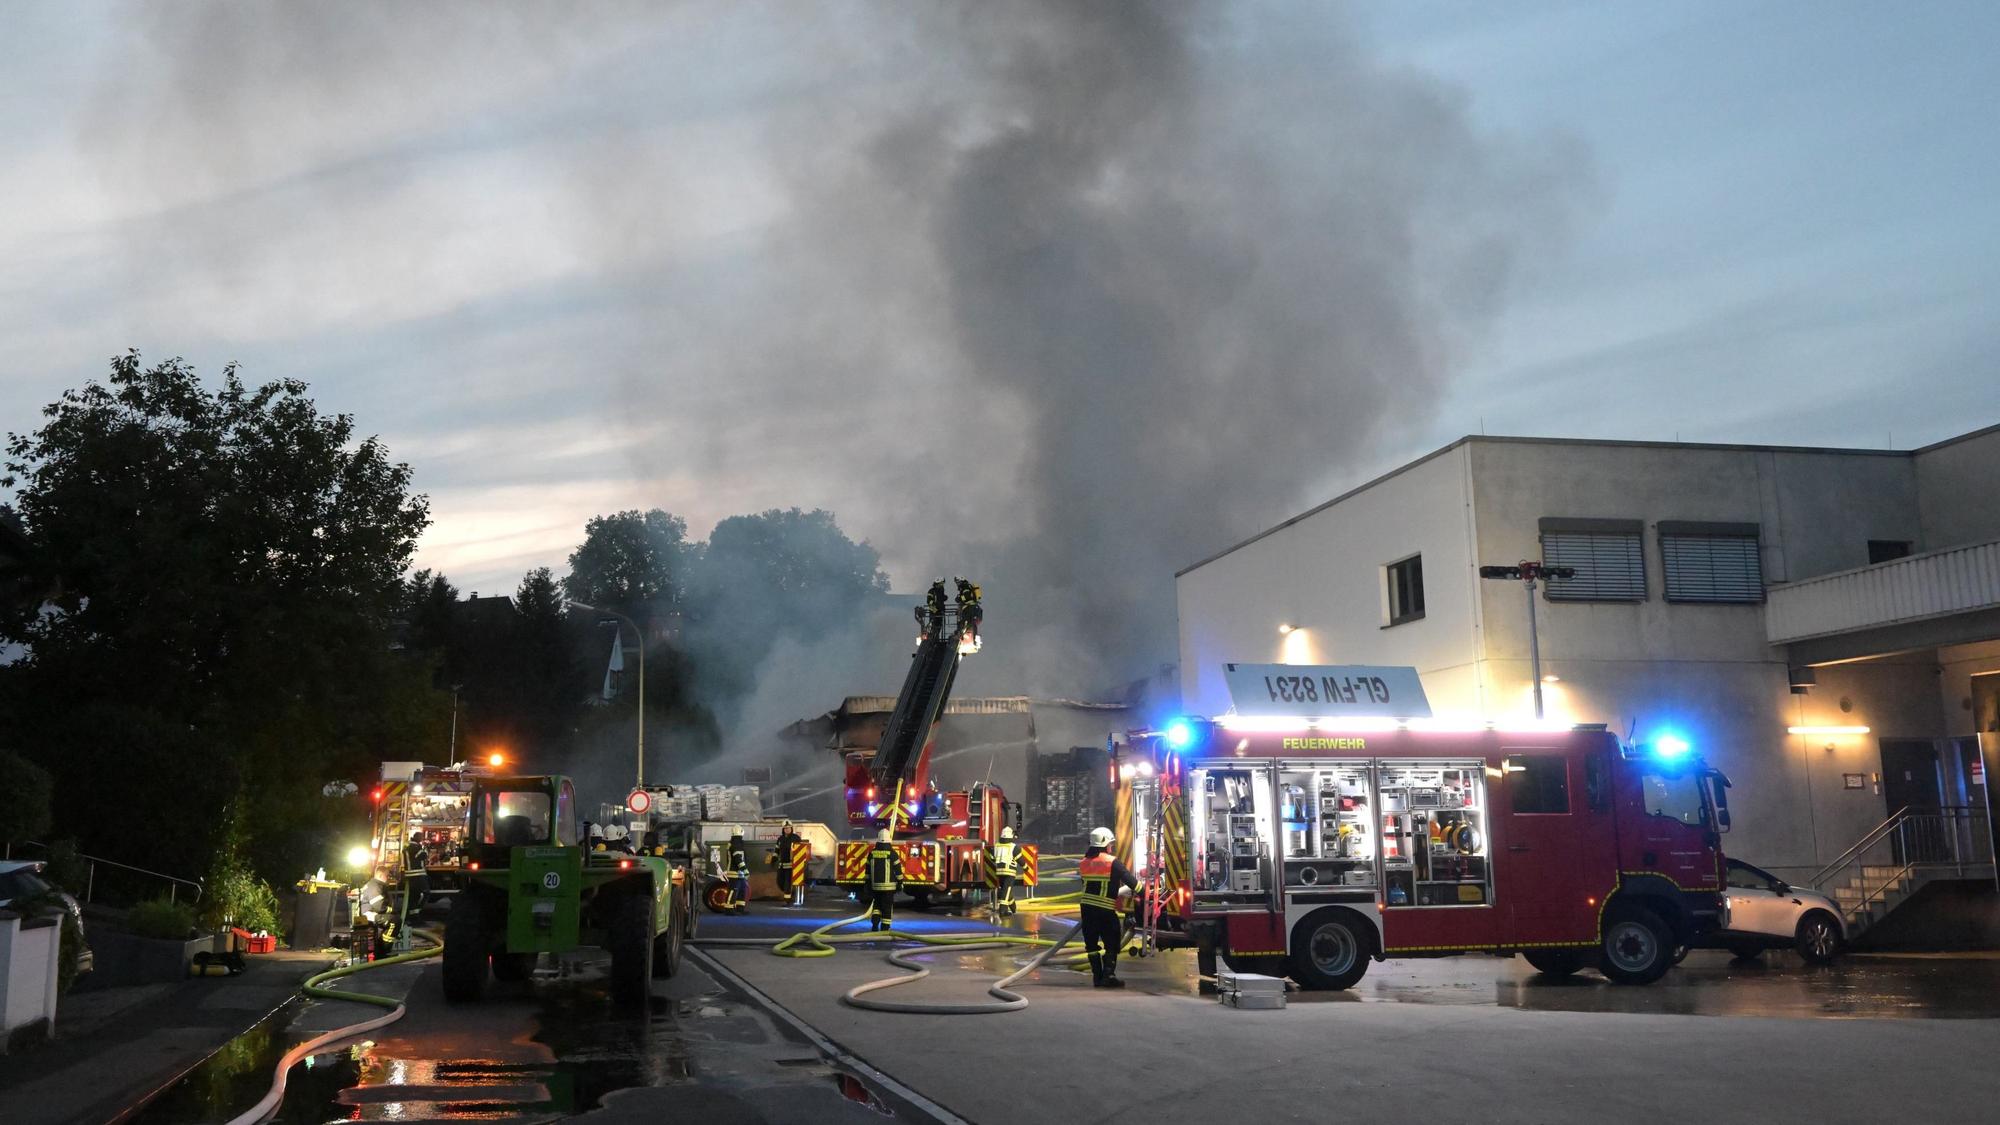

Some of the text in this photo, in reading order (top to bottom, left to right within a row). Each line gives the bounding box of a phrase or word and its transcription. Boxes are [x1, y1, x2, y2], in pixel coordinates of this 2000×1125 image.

[1265, 676, 1390, 703] GL-FW 8231
[1283, 737, 1365, 749] FEUERWEHR
[546, 874, 558, 886] 20
